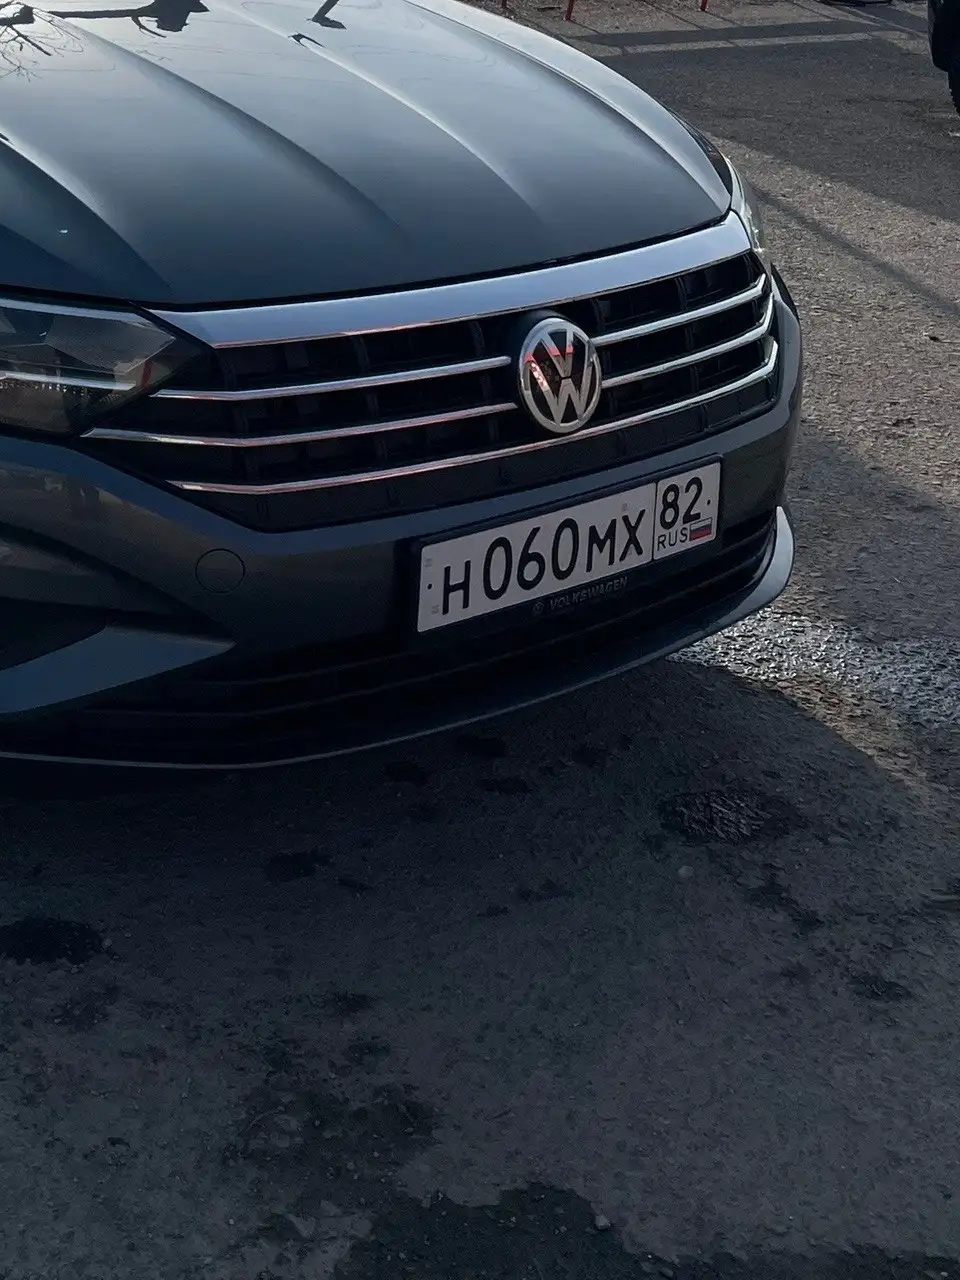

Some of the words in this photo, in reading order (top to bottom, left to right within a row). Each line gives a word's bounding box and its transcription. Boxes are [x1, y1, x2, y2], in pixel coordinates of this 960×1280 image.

[442, 508, 646, 616] Н060МХ
[660, 476, 703, 530] 82
[657, 527, 688, 552] RUS
[549, 576, 628, 611] VOLKSWAGEN
